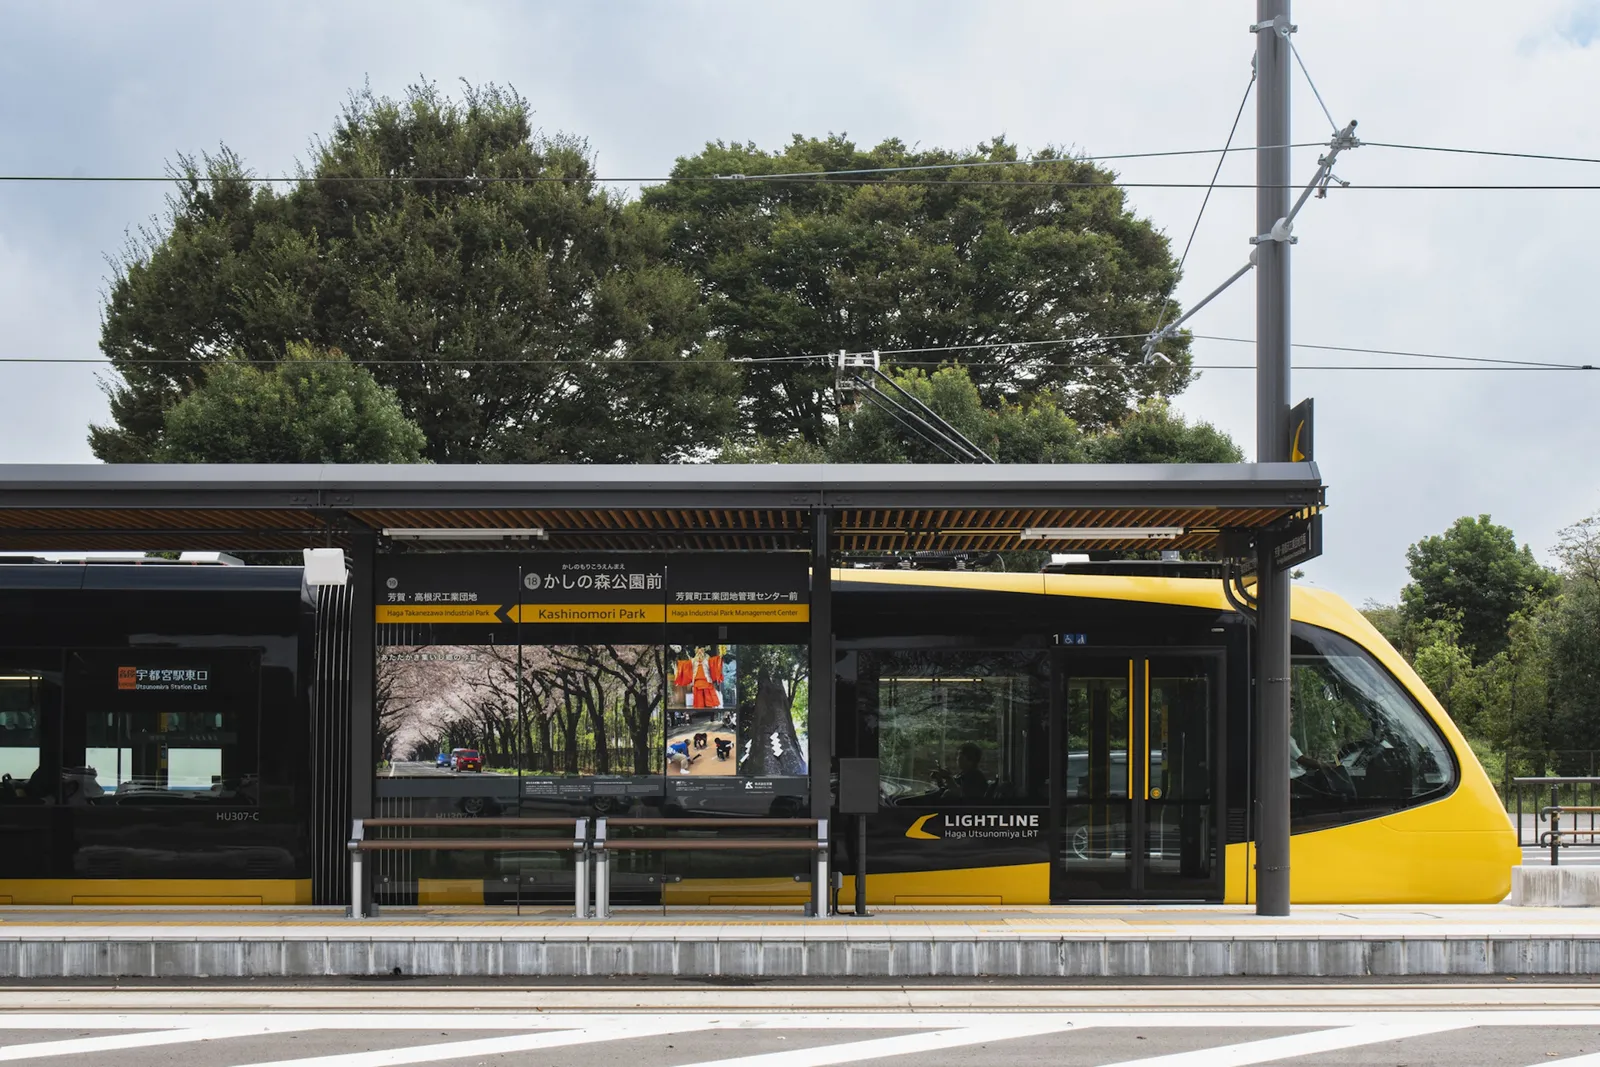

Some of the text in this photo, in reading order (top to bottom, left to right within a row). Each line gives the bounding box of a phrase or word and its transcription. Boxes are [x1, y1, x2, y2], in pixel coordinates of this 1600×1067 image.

[526, 573, 662, 590] 18 かしの森公園前
[387, 592, 478, 602] 芳賀・高根沢工業団地
[675, 592, 798, 601] 芳賀町工業団地管理センター前
[387, 609, 490, 617] Haga Takanezawa Industrial Park
[538, 609, 646, 619] Kashinomori Park
[672, 610, 688, 618] Haga
[735, 610, 777, 618] Management
[1053, 634, 1060, 644] 1
[136, 669, 208, 682] 宇都宮駅東口
[216, 812, 260, 821] HU307-C
[944, 814, 1040, 827] LIGHTLINE
[944, 829, 1040, 839] Haga Utsunomiya LRT
